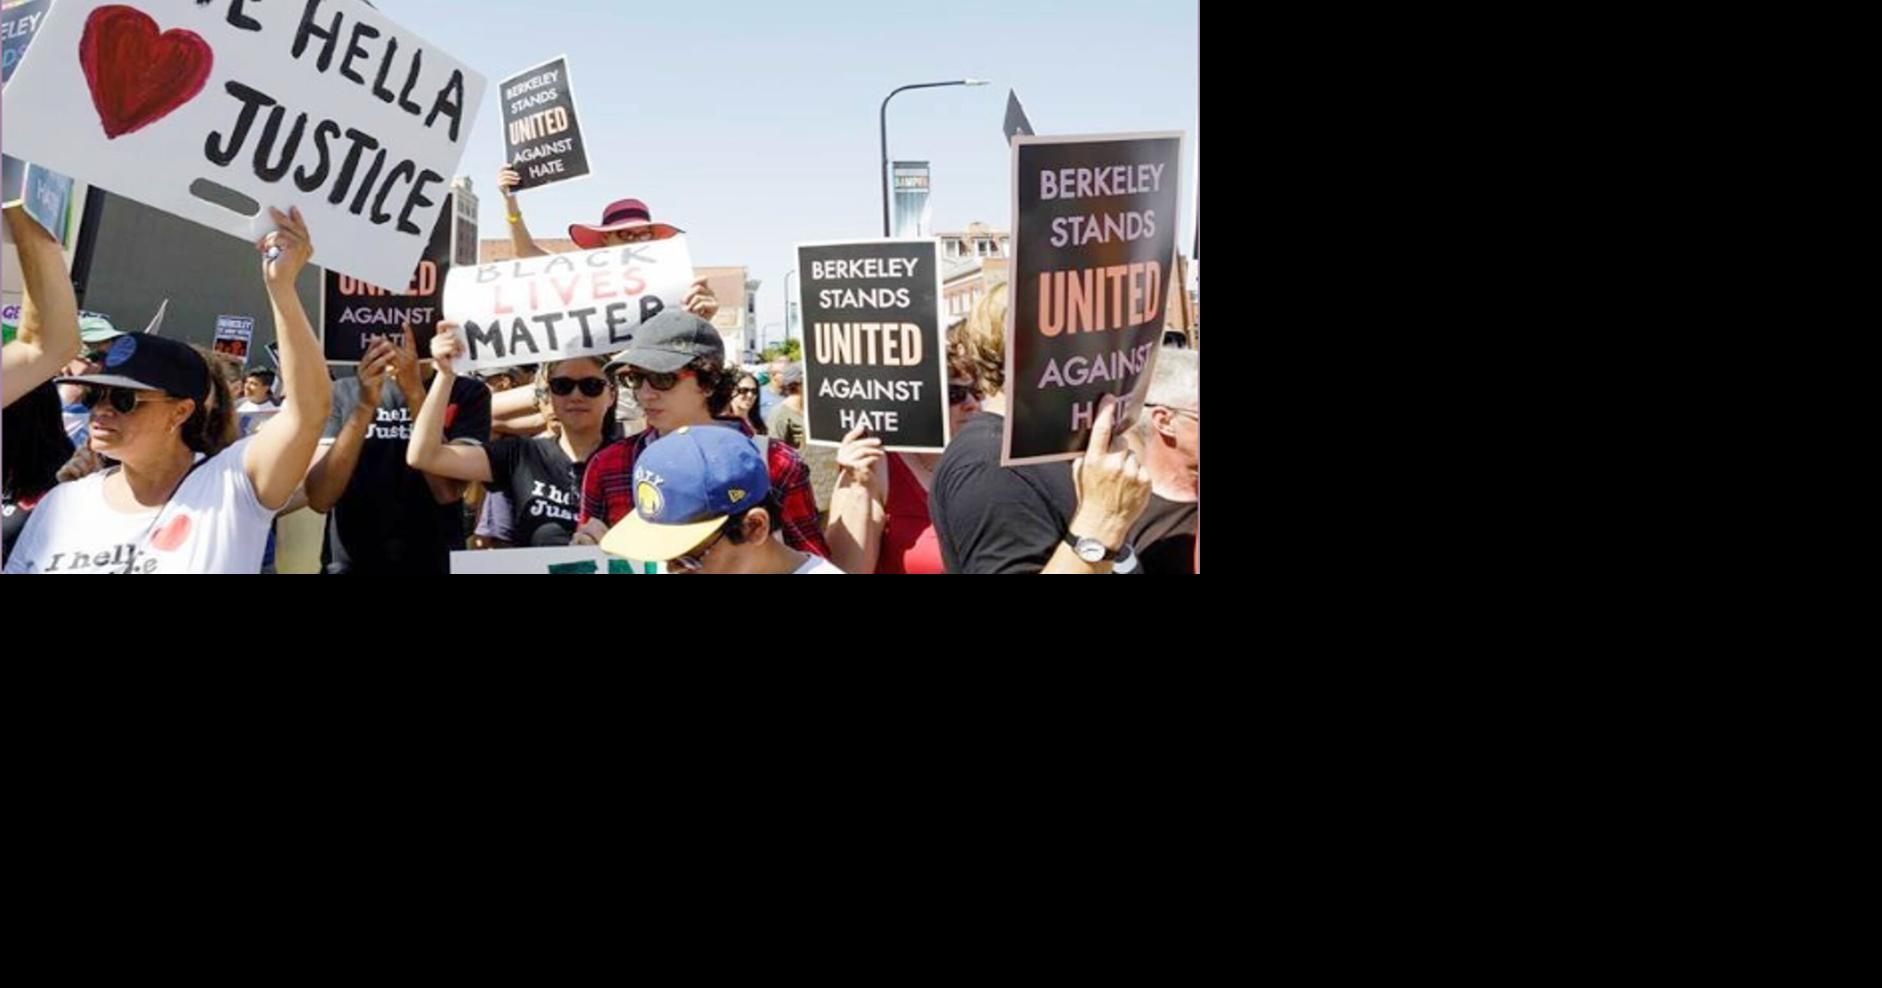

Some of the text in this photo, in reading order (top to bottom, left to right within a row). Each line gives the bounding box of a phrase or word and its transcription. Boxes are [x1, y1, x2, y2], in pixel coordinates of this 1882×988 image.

[291, 0, 463, 142] HELLA
[506, 69, 559, 100] BERKELEY
[511, 88, 558, 114] STANDS
[509, 106, 569, 145] UNITED
[204, 80, 444, 235] JUSTICE
[513, 138, 573, 164] AGAINST
[529, 159, 565, 178] HATE
[1040, 163, 1164, 200] BERKELEY
[1050, 210, 1156, 248] STANDS
[475, 245, 657, 284] BLACK
[811, 257, 918, 280] BERKELEY
[493, 266, 647, 315] LIVES
[819, 287, 911, 309] STANDS
[1038, 260, 1161, 338] UNITED
[338, 307, 434, 325] AGAINST
[814, 322, 923, 367] UNITED
[1037, 341, 1153, 389] AGAINST
[818, 378, 923, 401] AGAINST
[840, 408, 899, 432] HATE
[531, 480, 546, 496] I
[45, 553, 65, 572] I
